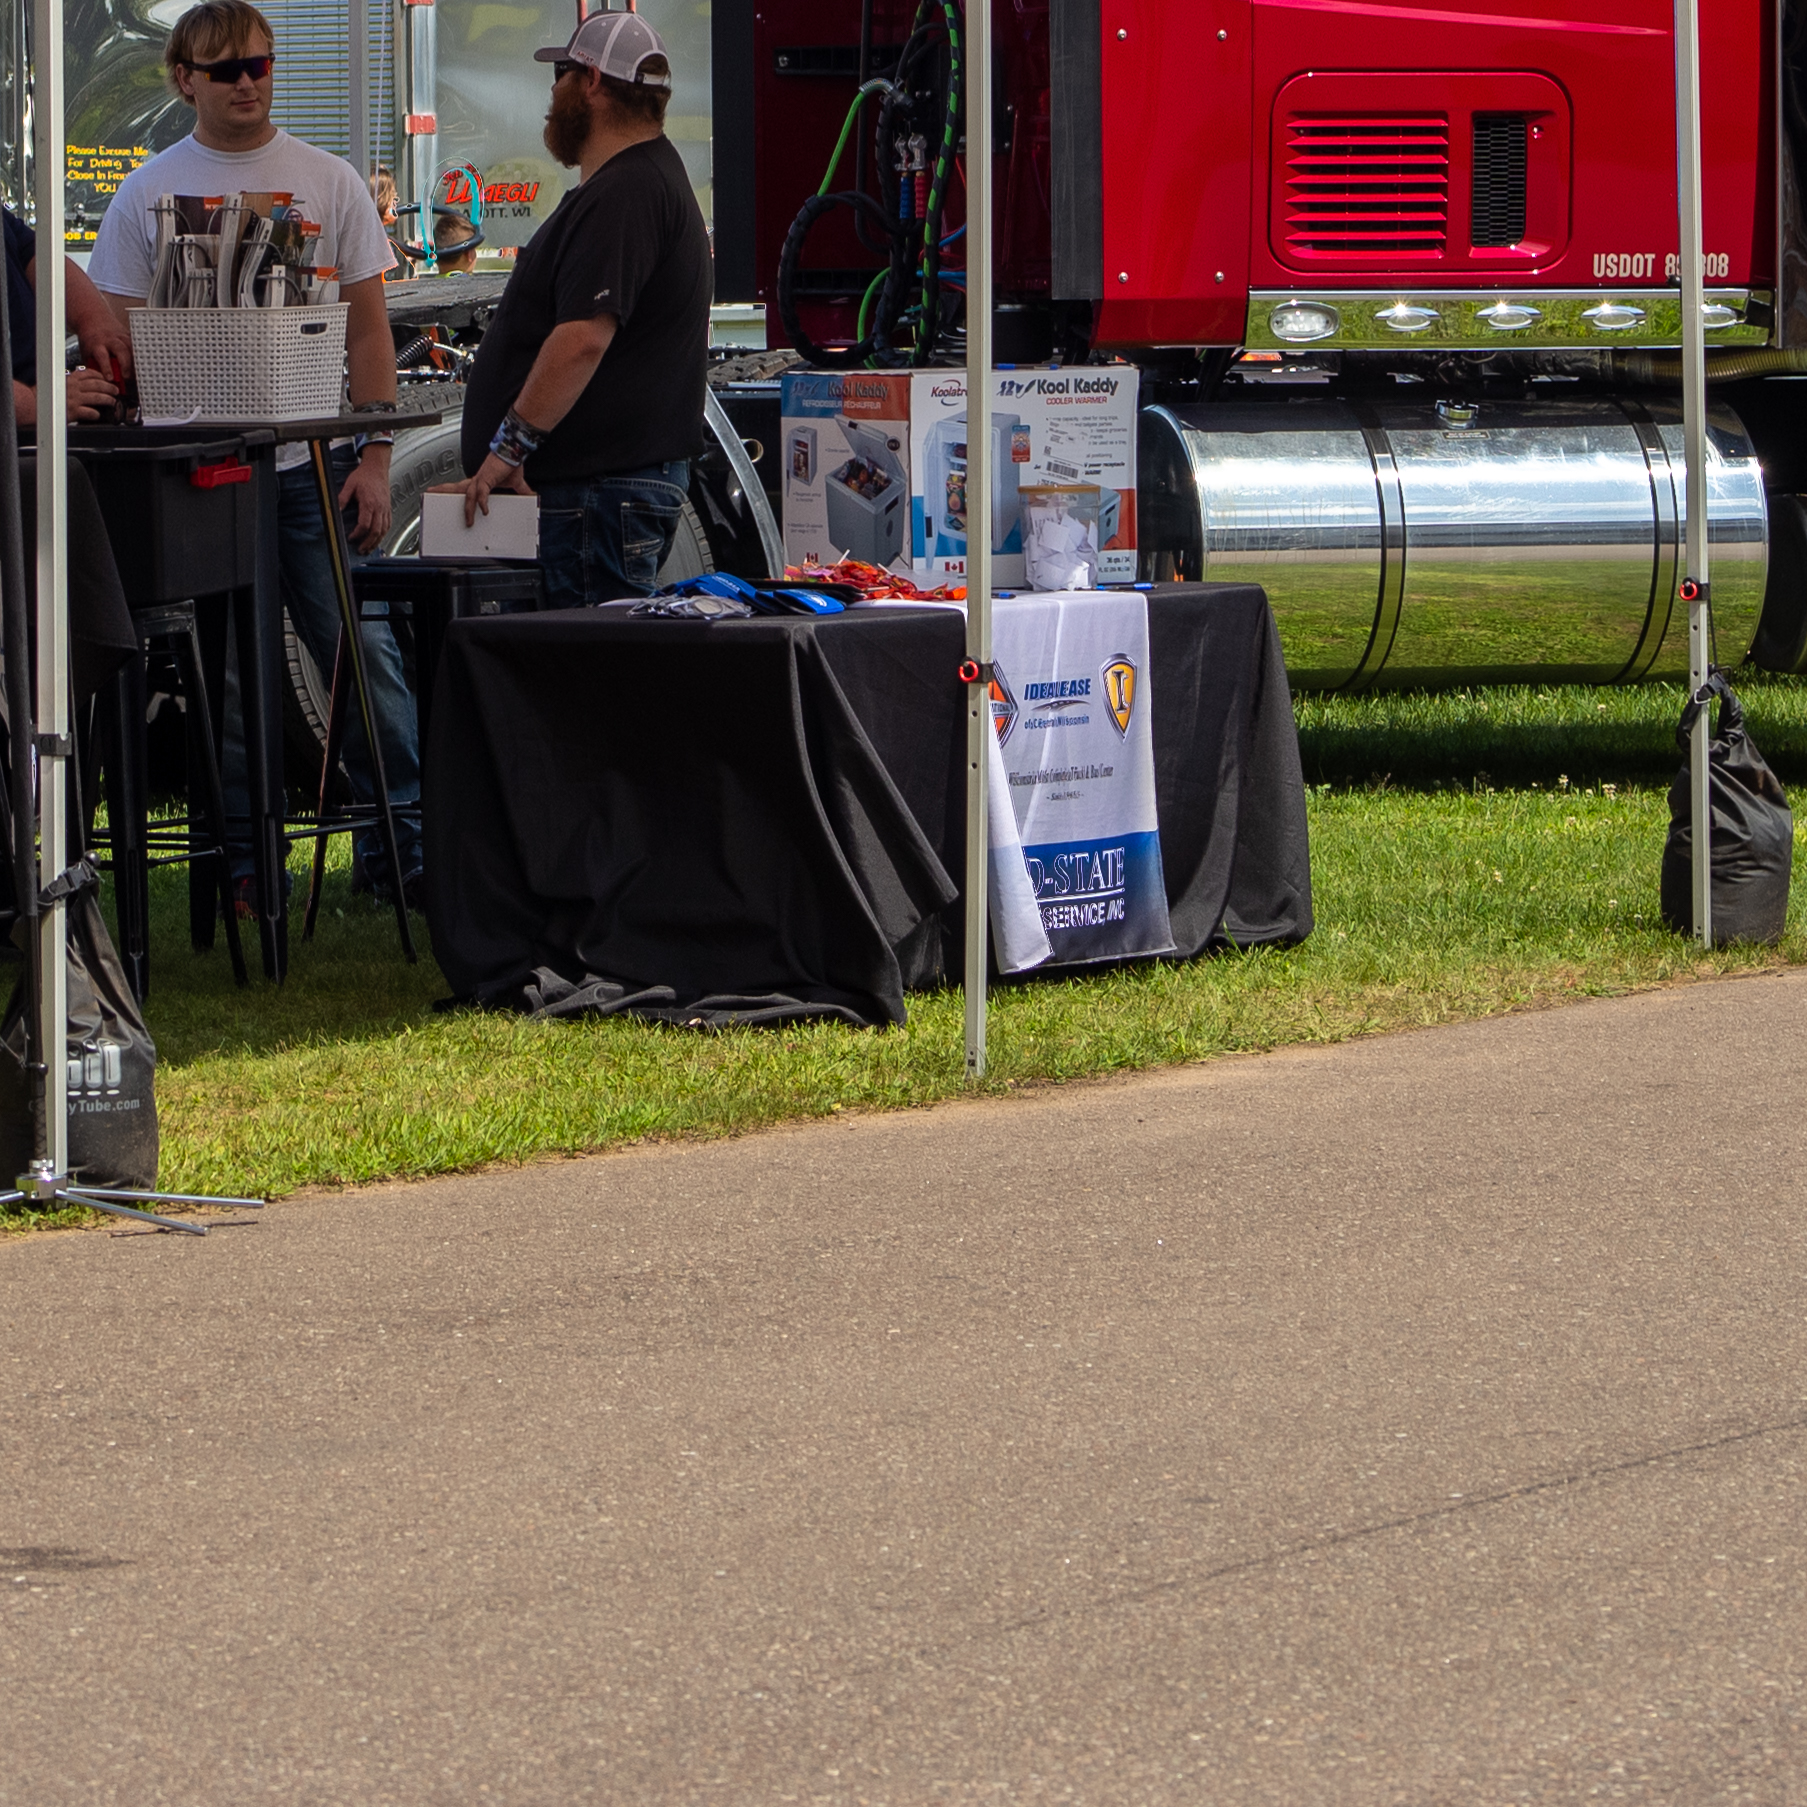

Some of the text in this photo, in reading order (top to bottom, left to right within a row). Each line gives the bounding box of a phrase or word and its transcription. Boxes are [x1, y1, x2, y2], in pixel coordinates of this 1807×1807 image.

[66, 145, 97, 155] Please
[133, 146, 149, 156] Me
[67, 157, 84, 167] For
[89, 158, 123, 170] Driving
[67, 169, 95, 180] Close
[97, 170, 106, 180] In
[94, 182, 117, 193] YOU
[512, 206, 531, 217] WI
[1593, 253, 1656, 278] USDOT
[827, 381, 889, 400] Kool Kaddy
[1037, 377, 1070, 394] Kool
[1074, 376, 1119, 397] Kaddy
[1045, 395, 1108, 406] COOLER WARMER
[1024, 678, 1091, 701] IDEALEASE
[1027, 847, 1125, 895] D-STATE
[29, 1099, 141, 1116] yTube.com
